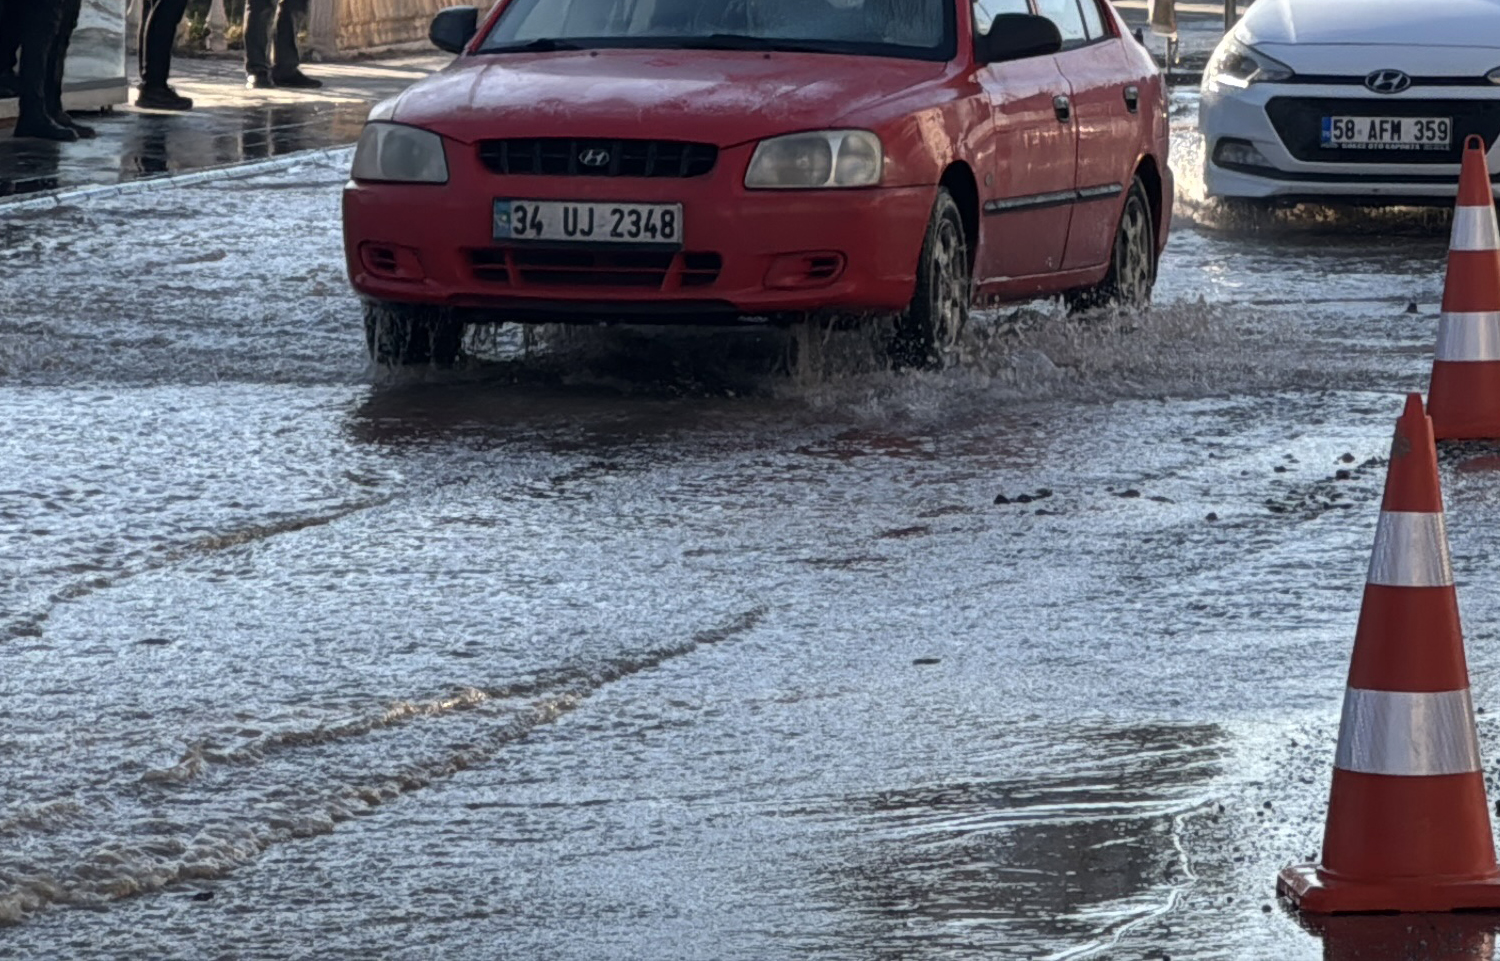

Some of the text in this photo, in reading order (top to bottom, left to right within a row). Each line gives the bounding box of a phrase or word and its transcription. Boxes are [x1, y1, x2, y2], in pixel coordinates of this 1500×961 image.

[1333, 119, 1448, 142] 58 AFM 359
[512, 205, 675, 239] 34 UJ 2348
